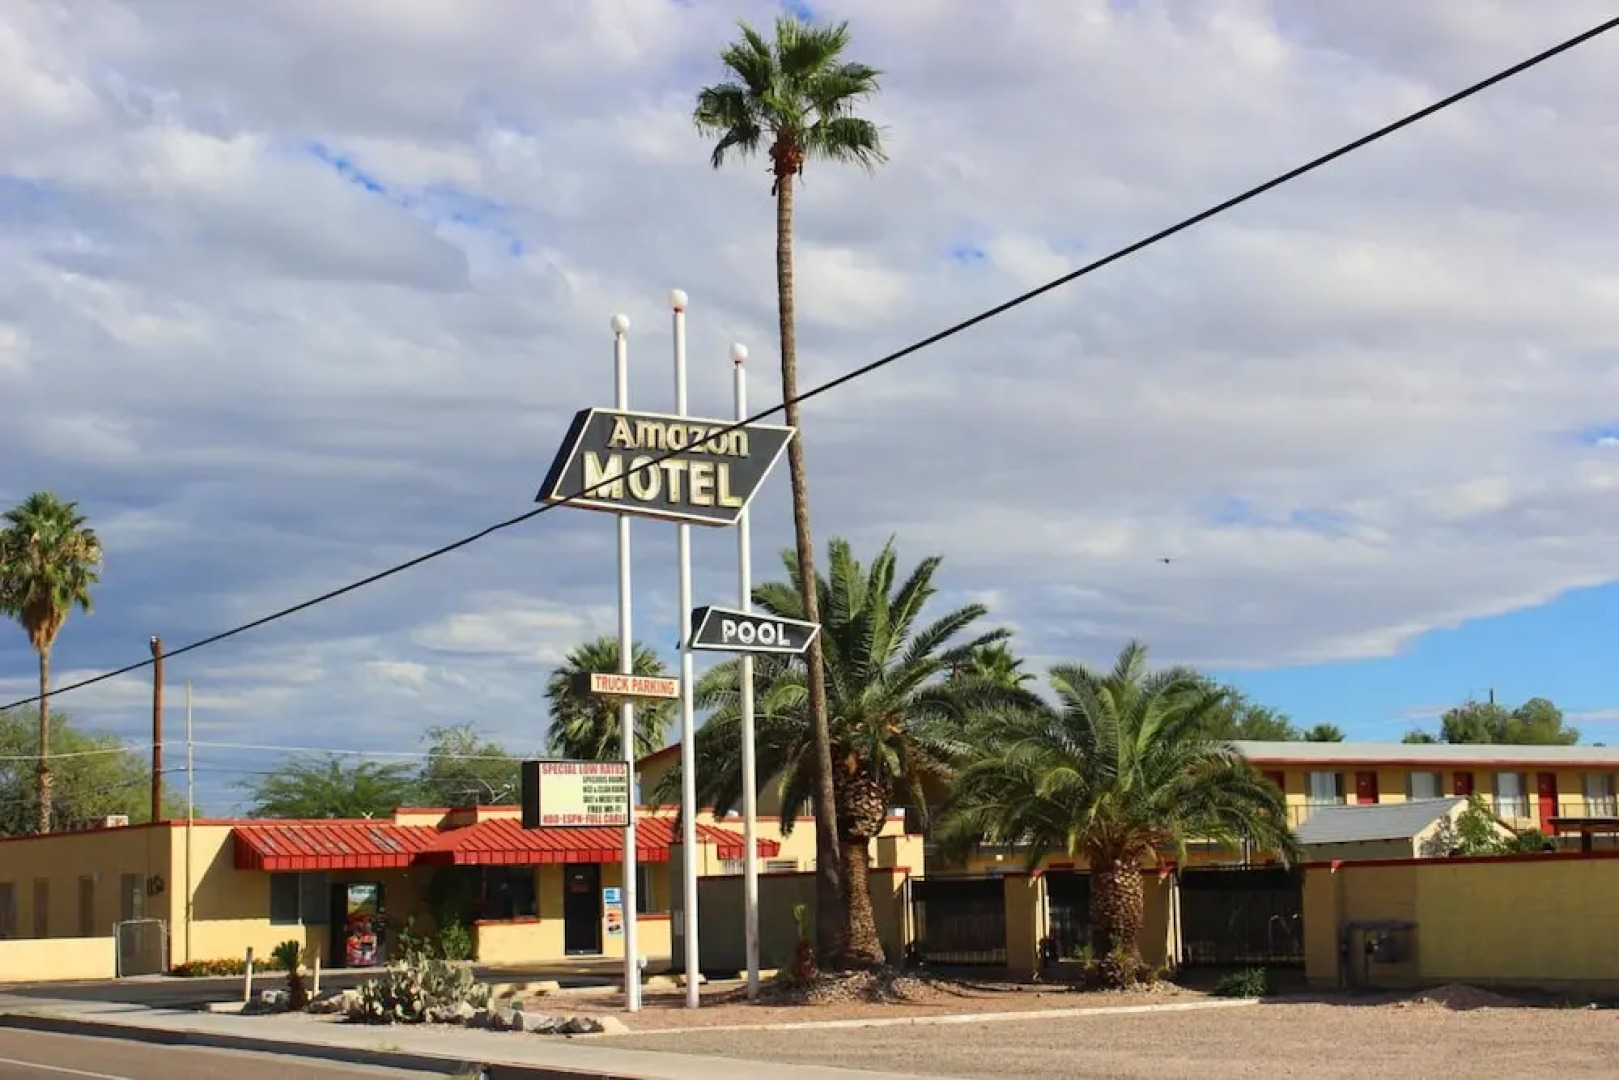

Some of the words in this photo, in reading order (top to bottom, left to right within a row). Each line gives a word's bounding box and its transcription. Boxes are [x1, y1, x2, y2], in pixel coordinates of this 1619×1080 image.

[607, 415, 750, 457] Amazon
[583, 451, 744, 507] MOTEL
[721, 619, 791, 646] POOL
[595, 675, 629, 691] TRUCK
[632, 678, 675, 695] PARKING
[542, 763, 576, 774] SPECIAL
[579, 763, 598, 774] LOW
[601, 763, 626, 774] RATES
